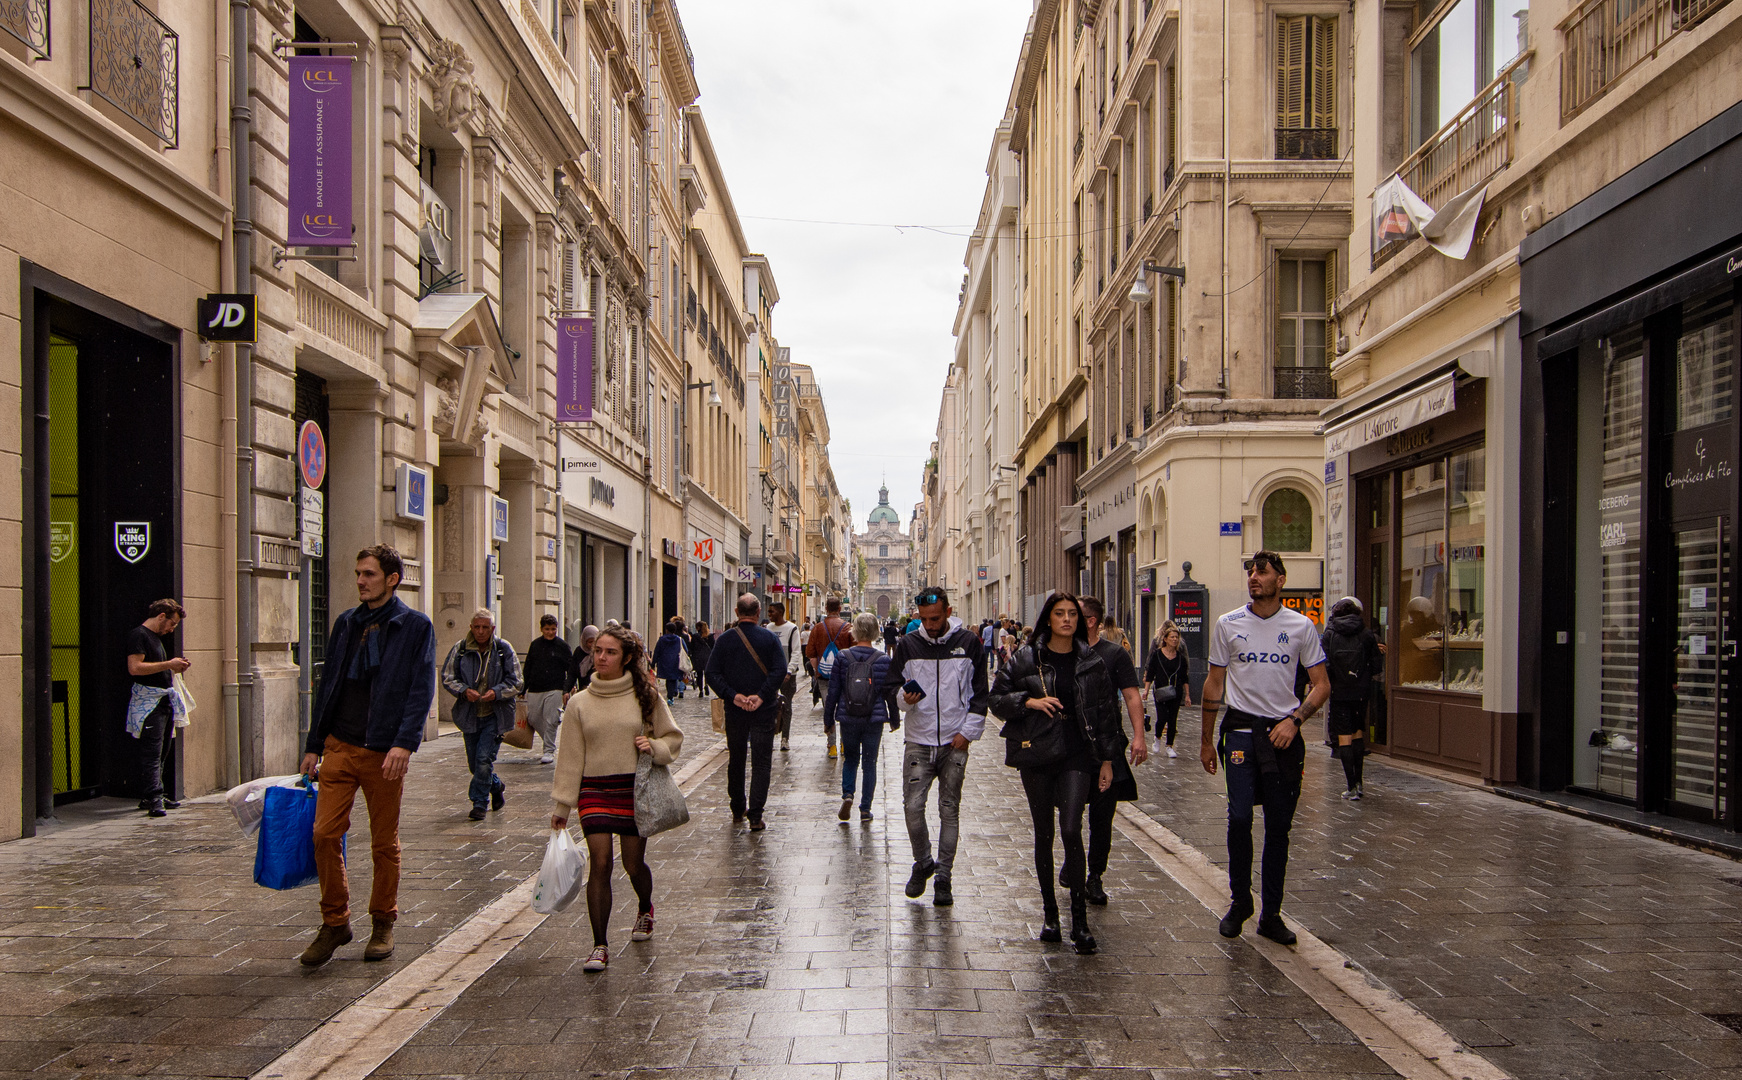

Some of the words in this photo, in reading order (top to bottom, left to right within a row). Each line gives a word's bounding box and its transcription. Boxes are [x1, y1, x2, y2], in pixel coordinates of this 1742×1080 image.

[306, 70, 338, 81] LCL
[316, 156, 323, 167] ET
[305, 215, 338, 226] LCL
[208, 303, 245, 328] JD
[778, 348, 789, 435] HOTEL
[1428, 397, 1446, 412] Vente
[1364, 416, 1398, 442] L'Aurore
[568, 461, 597, 469] pimkie
[1665, 468, 1703, 490] Complices
[1717, 460, 1732, 479] Flo
[409, 480, 422, 496] LCL
[1599, 494, 1628, 510] ICEBERG
[496, 508, 505, 522] LCL
[1600, 522, 1626, 540] KARL
[1282, 598, 1300, 608] ICI
[1304, 598, 1324, 608] VO
[1238, 652, 1290, 664] CAZOO
